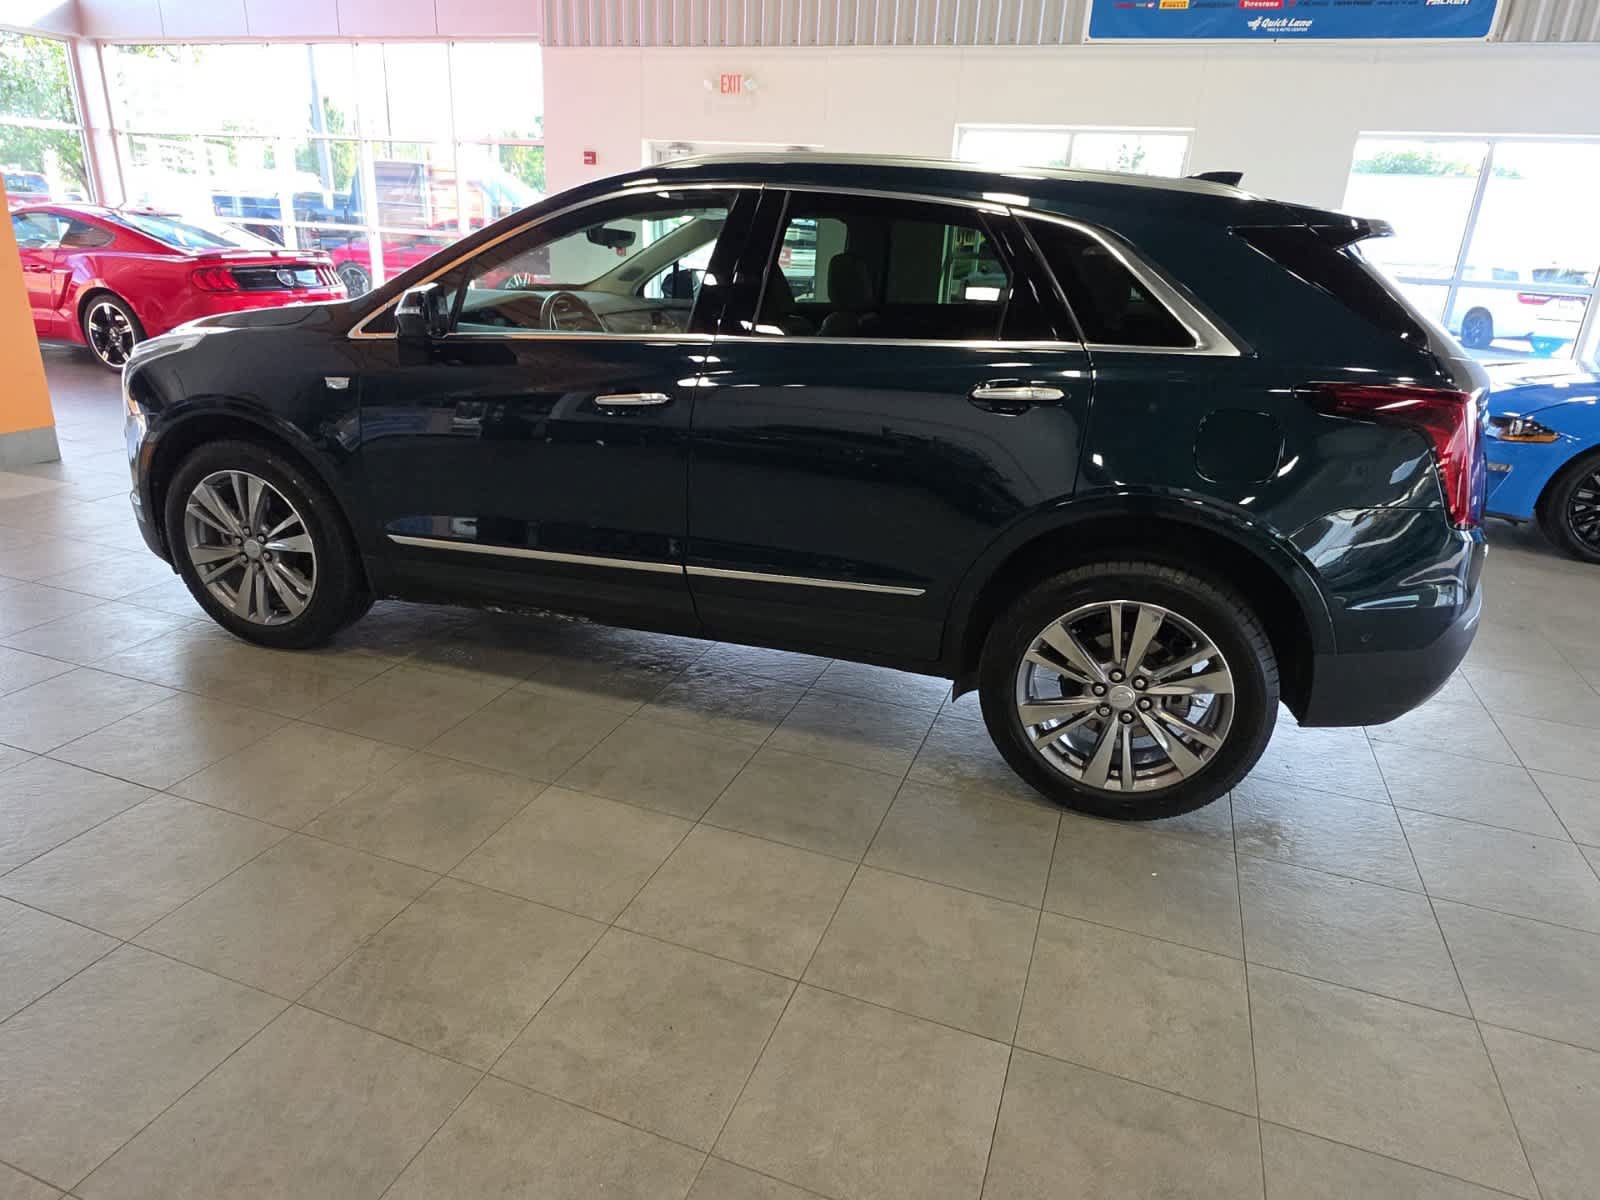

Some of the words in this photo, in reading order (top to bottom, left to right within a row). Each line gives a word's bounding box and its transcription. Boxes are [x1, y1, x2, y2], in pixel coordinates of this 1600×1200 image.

[1261, 17, 1288, 28] Quick
[1288, 18, 1313, 27] Lane
[721, 74, 742, 94] EXIT
